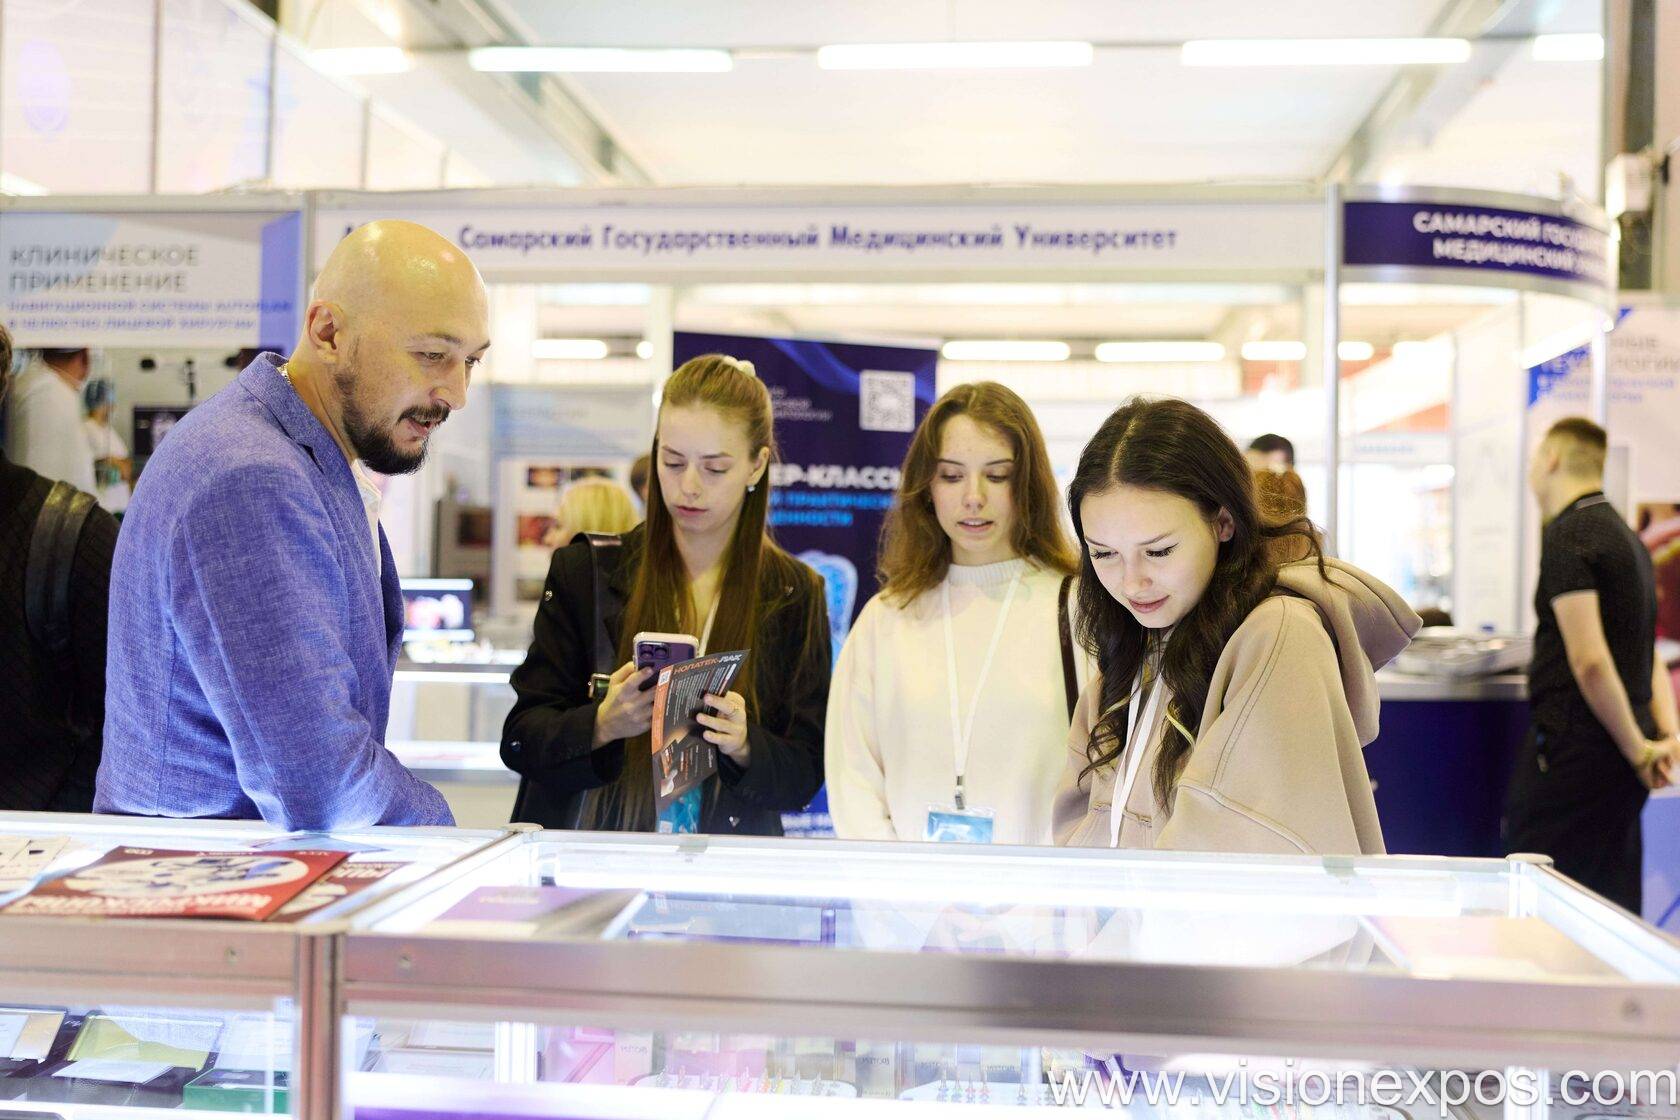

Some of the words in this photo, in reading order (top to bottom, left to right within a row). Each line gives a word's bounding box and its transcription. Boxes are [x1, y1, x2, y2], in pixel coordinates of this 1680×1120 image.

[602, 224, 819, 257] Государственный
[829, 222, 1004, 254] Медицинский
[1014, 222, 1179, 256] Университет
[1412, 210, 1542, 241] САМАРСКИЙ
[8, 244, 200, 267] КЛИНИЧЕСКОЕ
[1432, 236, 1575, 273] МЕДИЦИНСКИЙ
[8, 271, 189, 293] ПРИМЕНЕНИЕ
